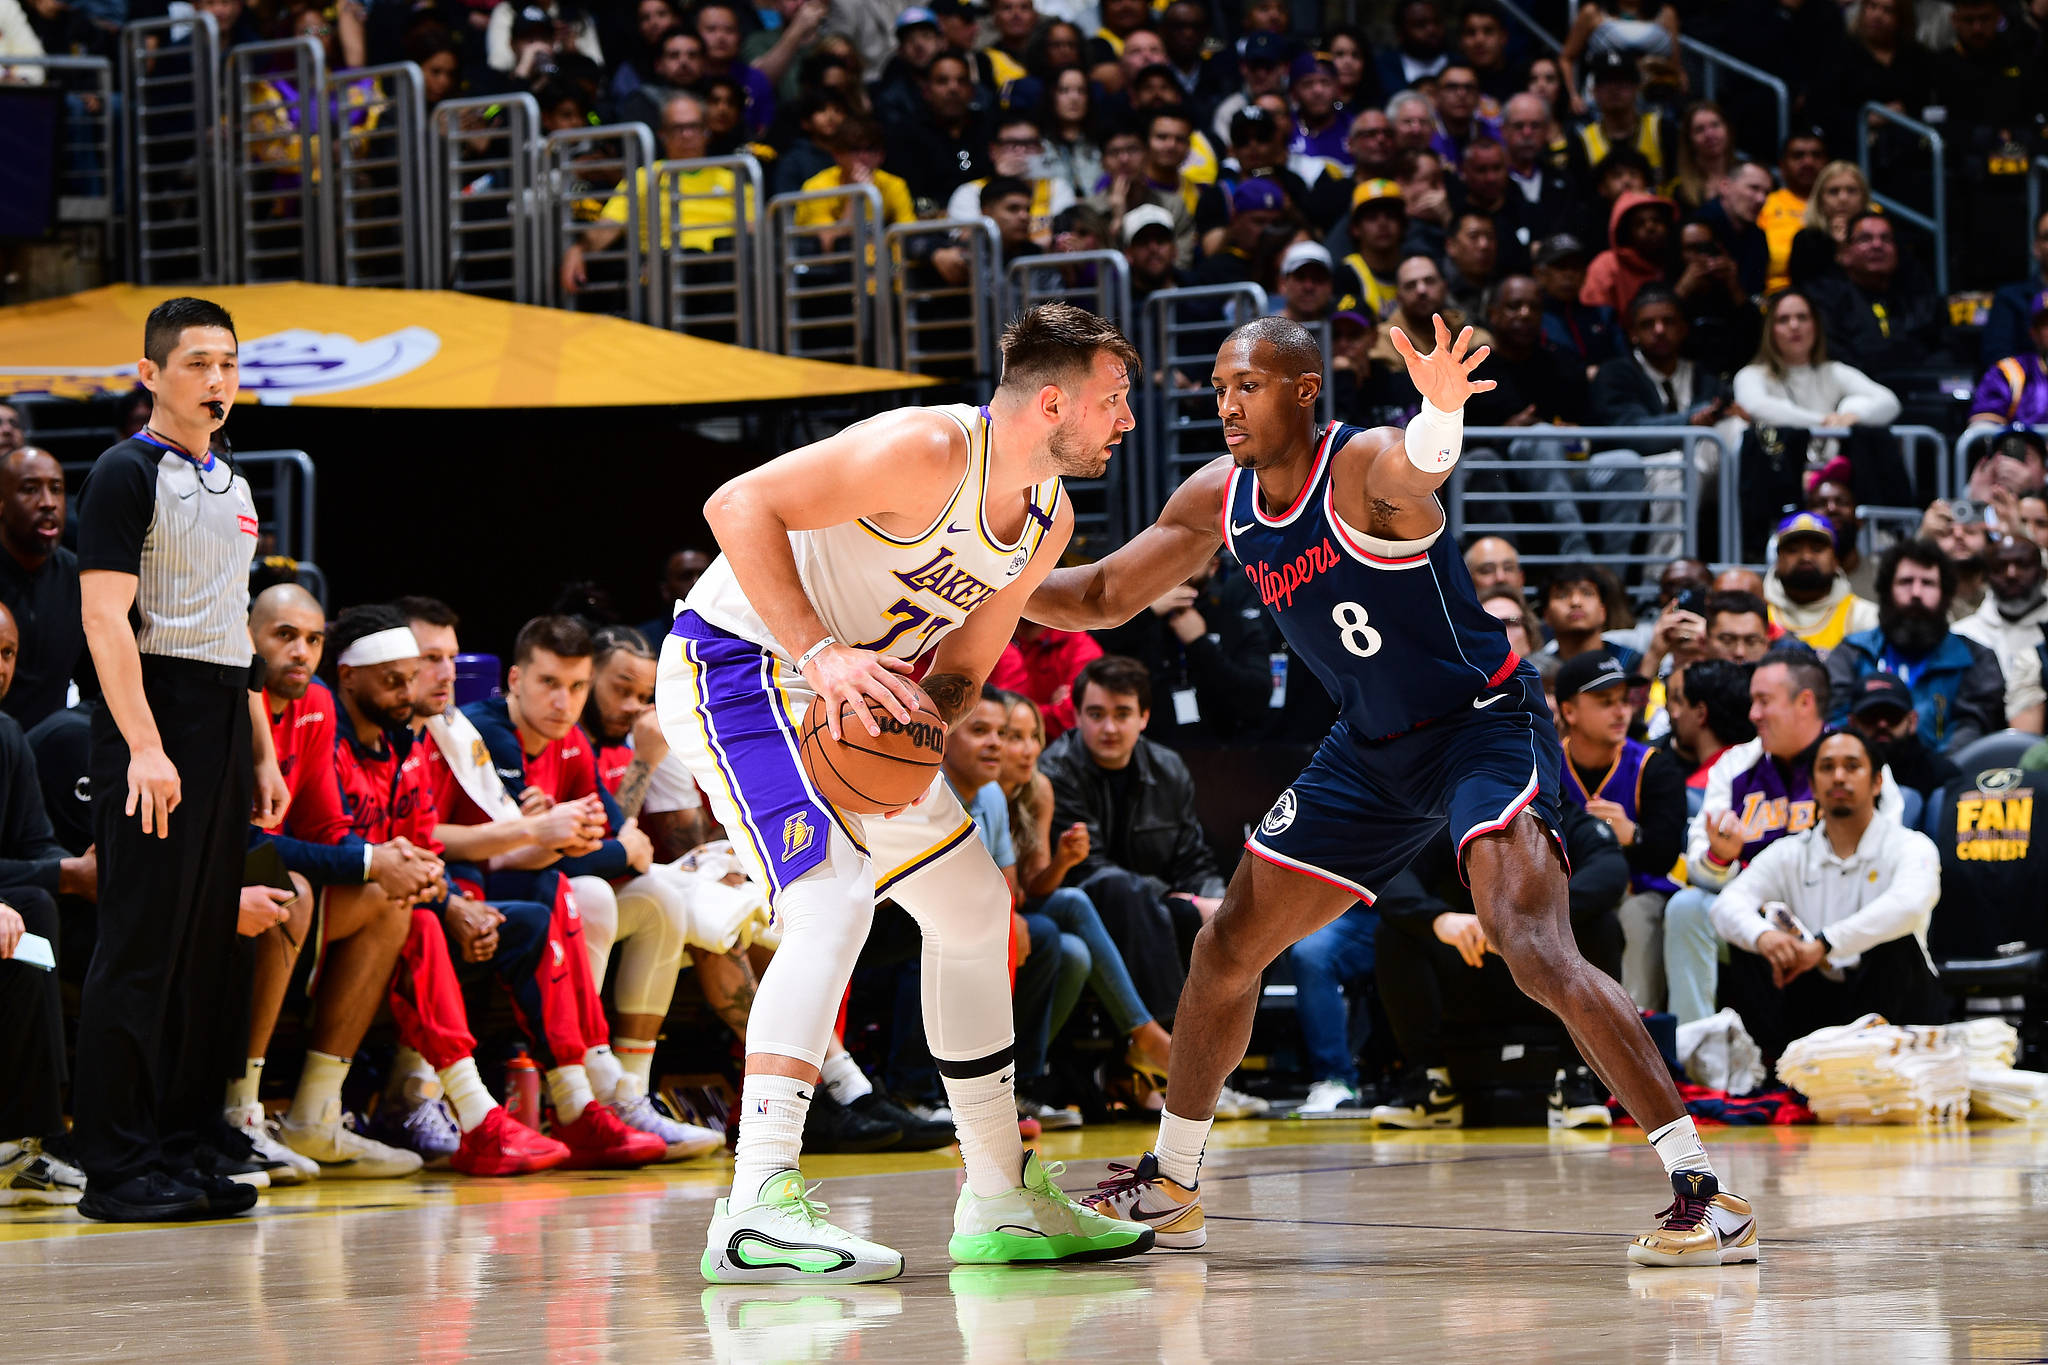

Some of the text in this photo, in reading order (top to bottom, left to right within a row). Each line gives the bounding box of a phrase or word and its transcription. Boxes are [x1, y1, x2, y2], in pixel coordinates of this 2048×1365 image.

[889, 545, 998, 613] LAKER
[1245, 537, 1341, 613] Clippers
[853, 595, 954, 664] 77
[1331, 601, 1383, 658] 8
[1956, 796, 2034, 832] FAN
[1956, 838, 2030, 862] CONTEST
